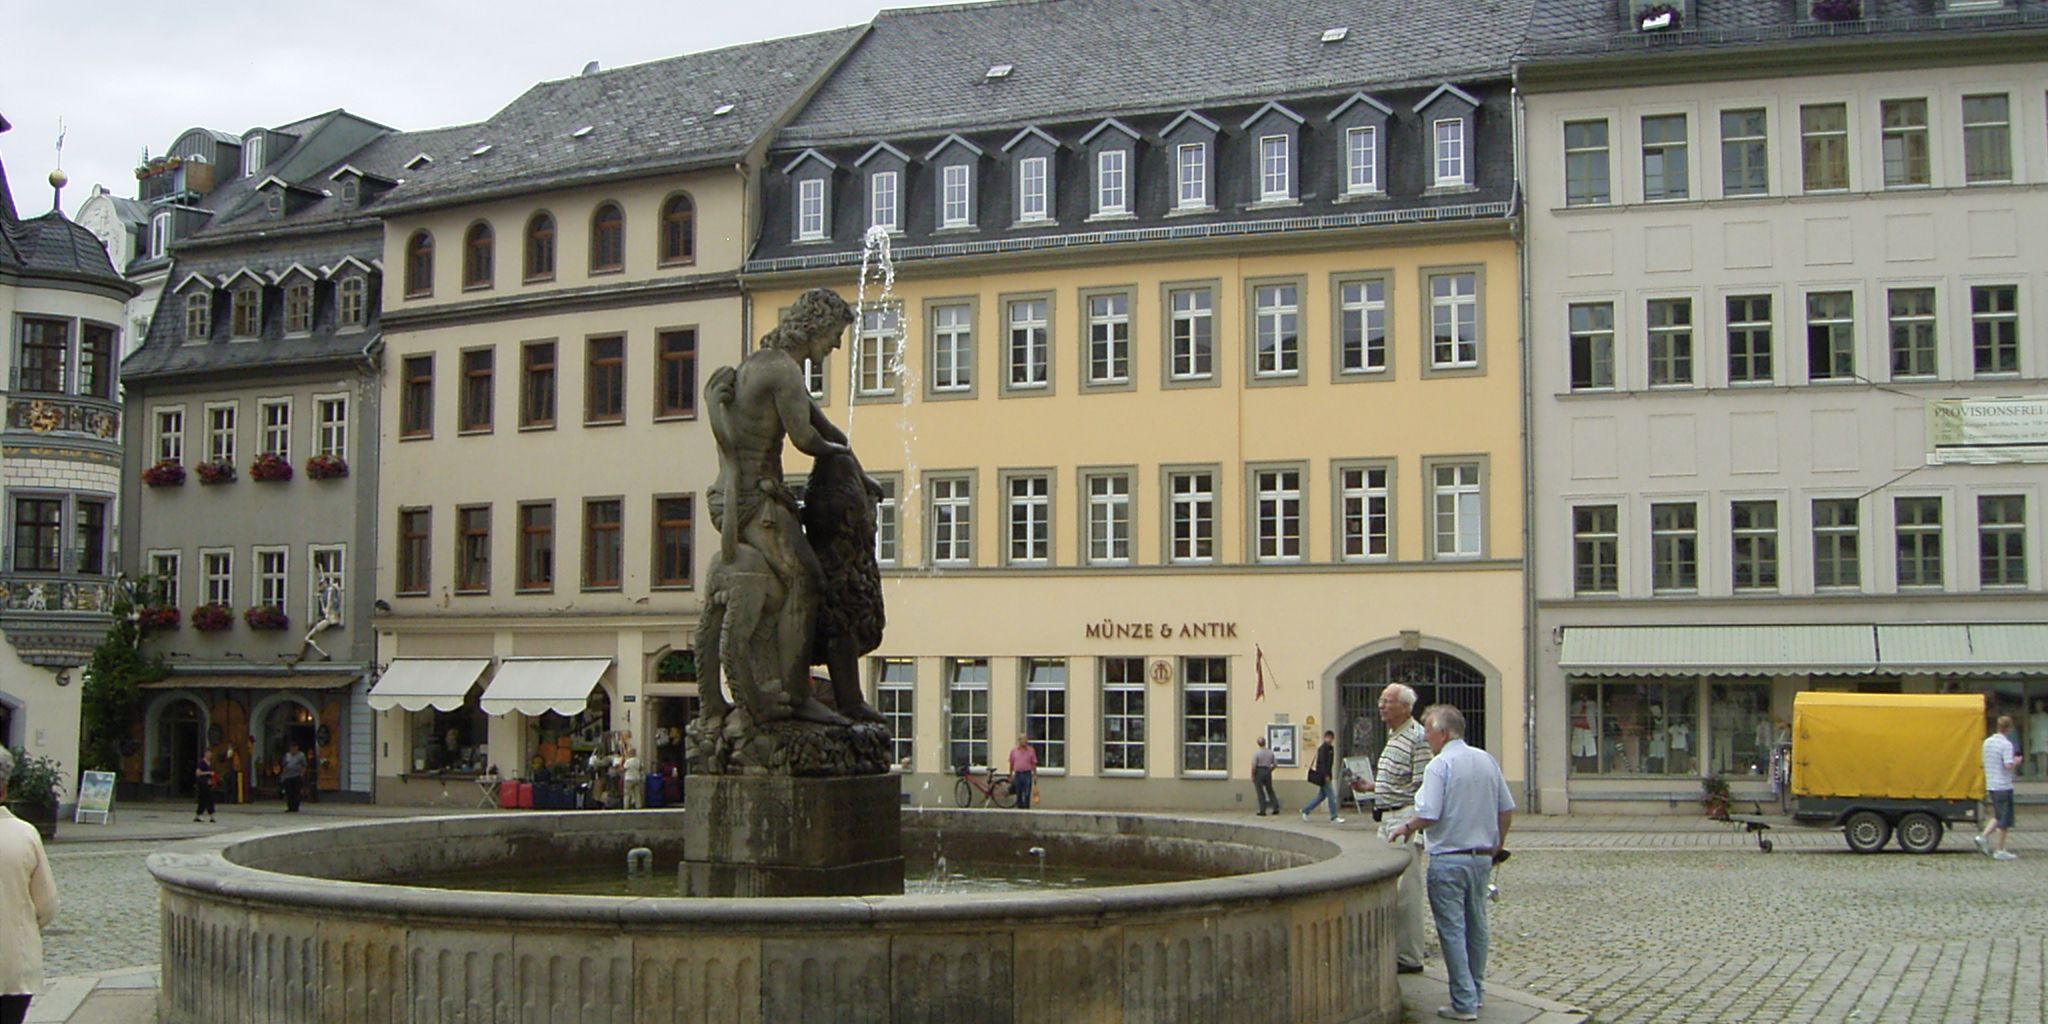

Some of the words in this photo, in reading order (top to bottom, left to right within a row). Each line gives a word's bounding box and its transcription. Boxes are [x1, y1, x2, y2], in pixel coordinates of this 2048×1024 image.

[1935, 405, 2043, 418] PROVISIONSFREI
[1086, 619, 1153, 639] MÜNZE
[1160, 623, 1173, 639] &
[1179, 622, 1238, 639] ANTIK
